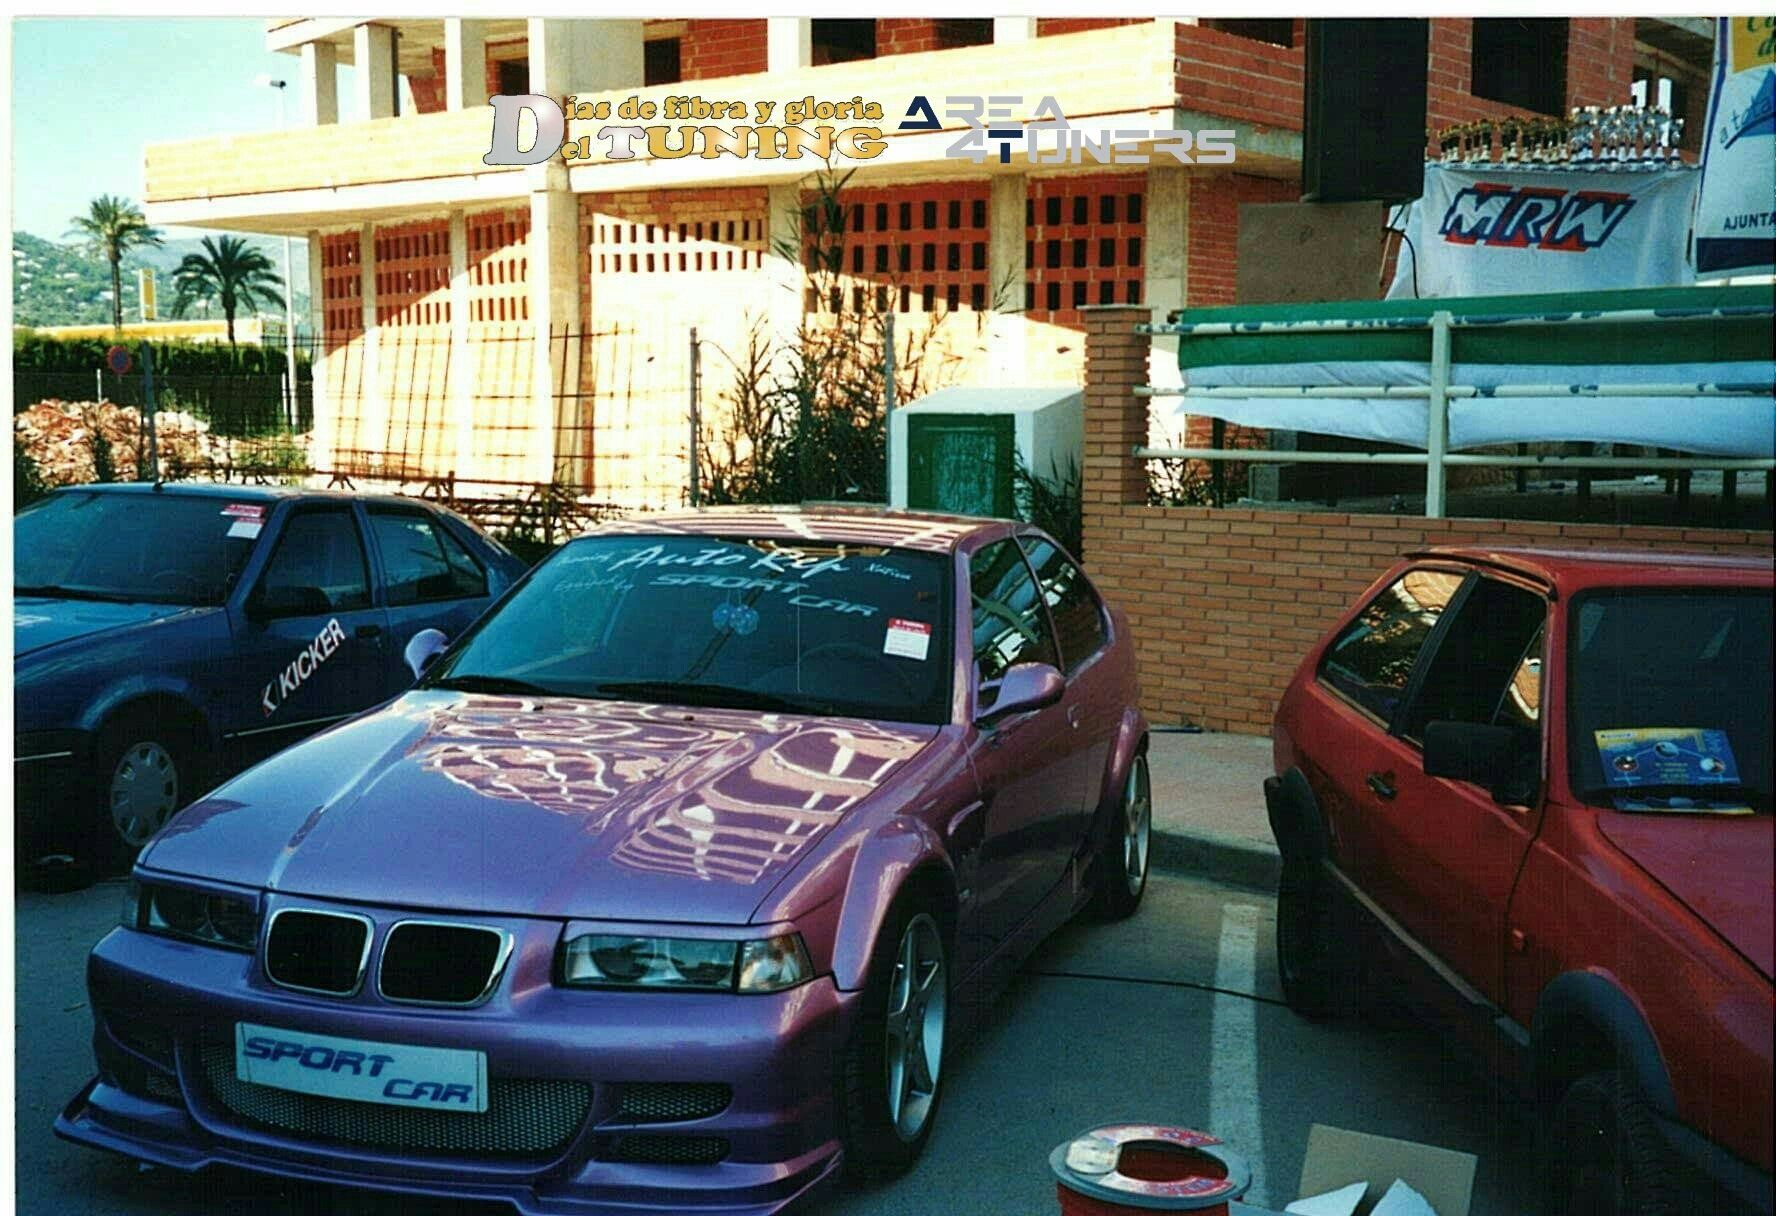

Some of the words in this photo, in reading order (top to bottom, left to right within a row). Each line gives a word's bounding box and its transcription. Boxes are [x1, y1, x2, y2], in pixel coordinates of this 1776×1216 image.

[1439, 182, 1637, 252] MRW
[606, 544, 747, 572] Auto
[650, 573, 810, 593] SPORT
[789, 595, 880, 617] CAR
[279, 617, 346, 698] KICKER
[243, 1036, 395, 1077] SPORT
[382, 1078, 474, 1104] CAR
